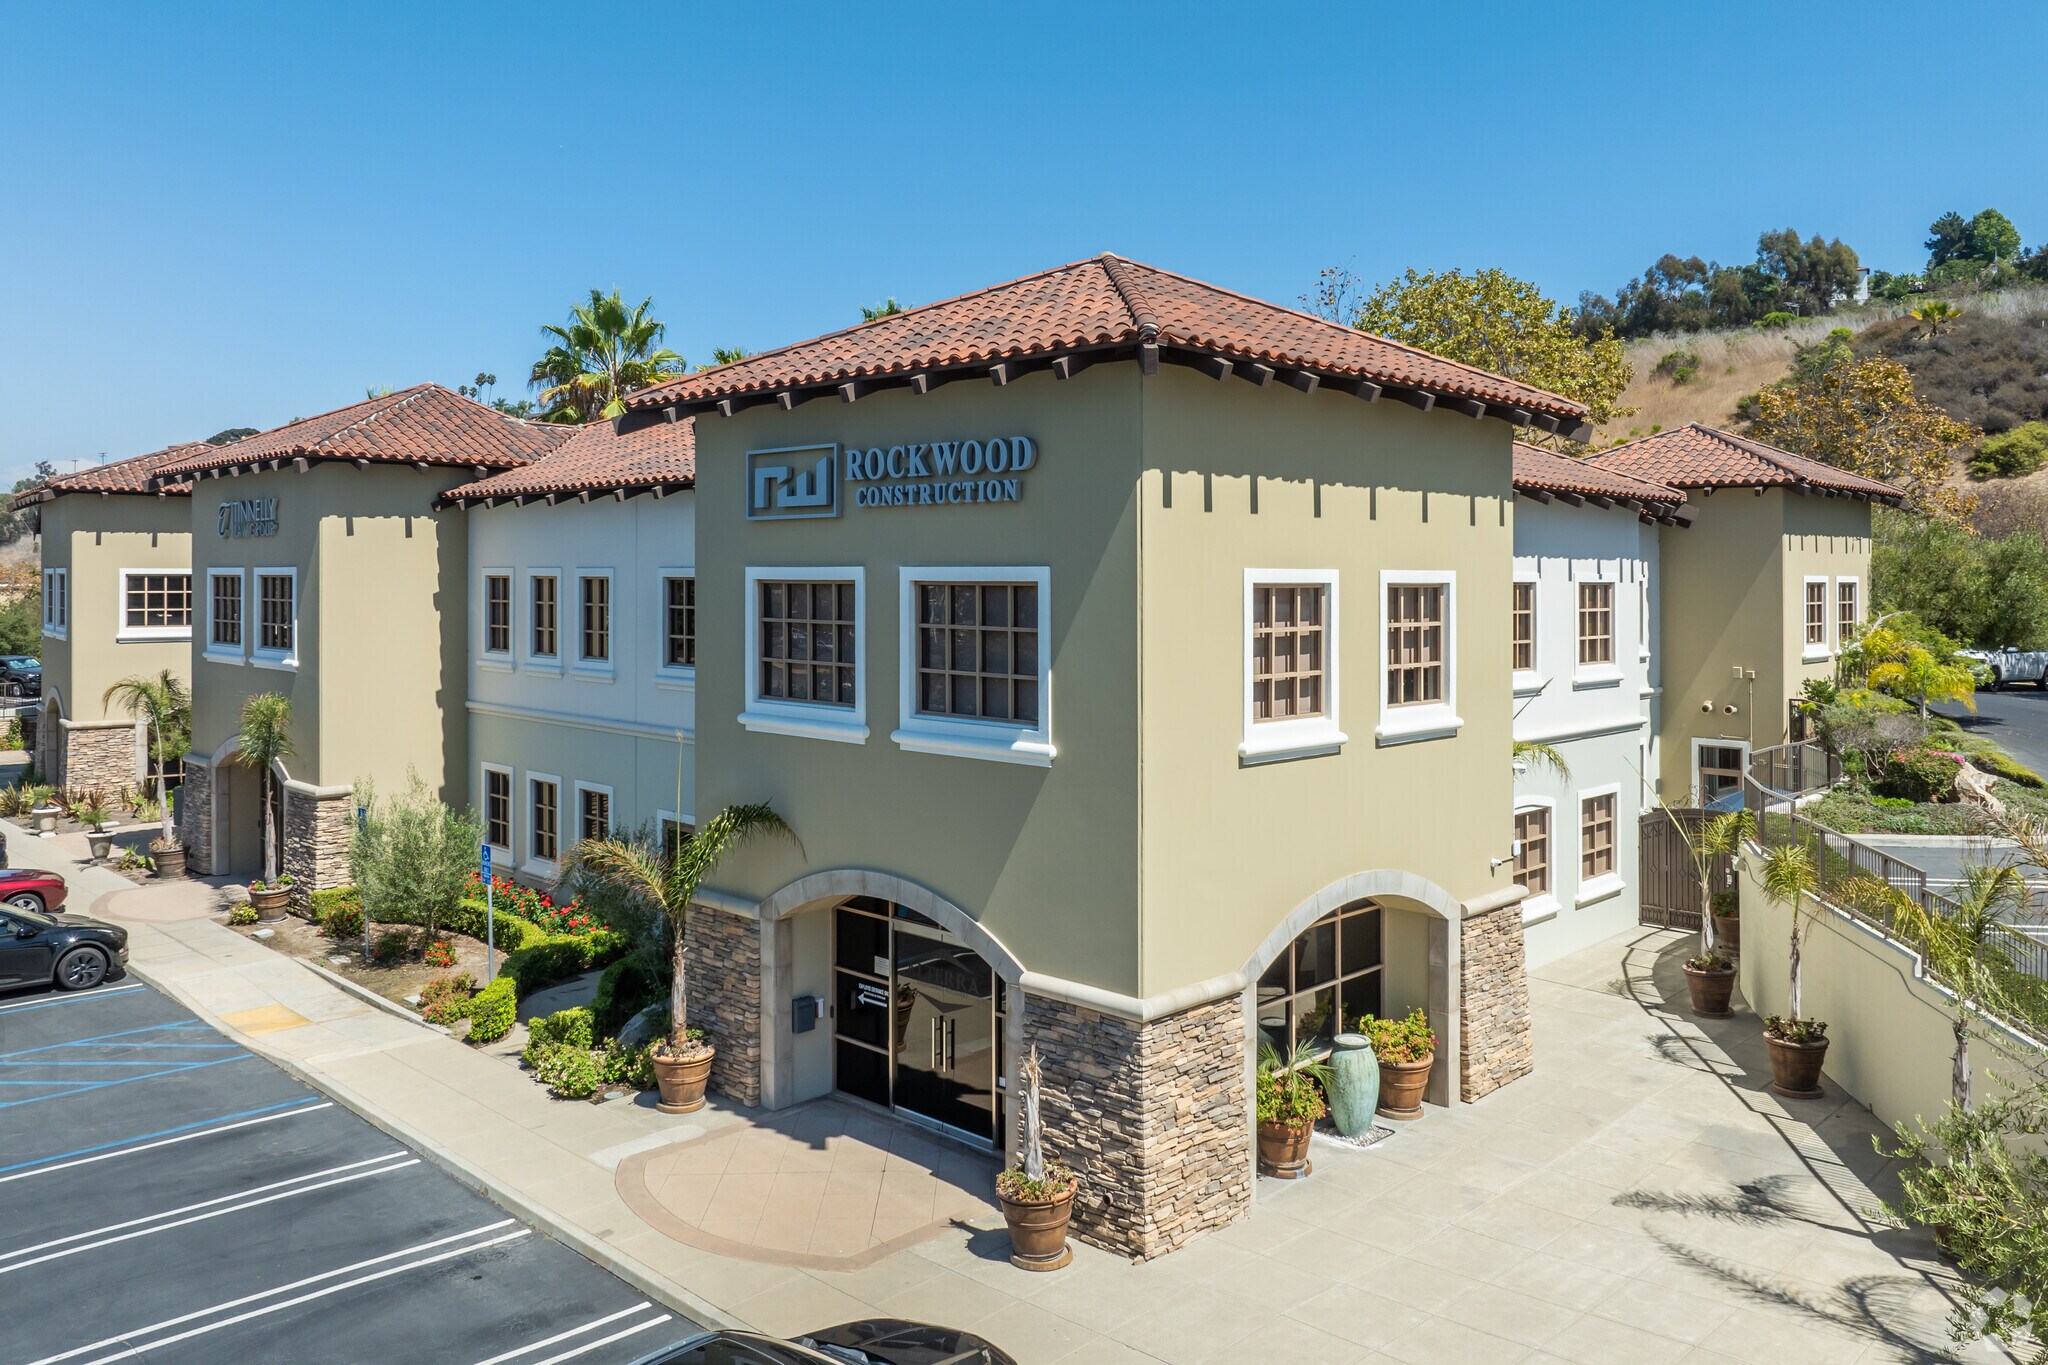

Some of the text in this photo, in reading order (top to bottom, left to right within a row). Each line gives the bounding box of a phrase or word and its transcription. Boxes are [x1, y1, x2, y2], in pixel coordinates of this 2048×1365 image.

[844, 436, 1036, 481] ROCKWOOD
[855, 479, 1019, 508] CONSTRUCTION
[232, 498, 276, 522] TINNELLY
[250, 520, 276, 537] GROUP
